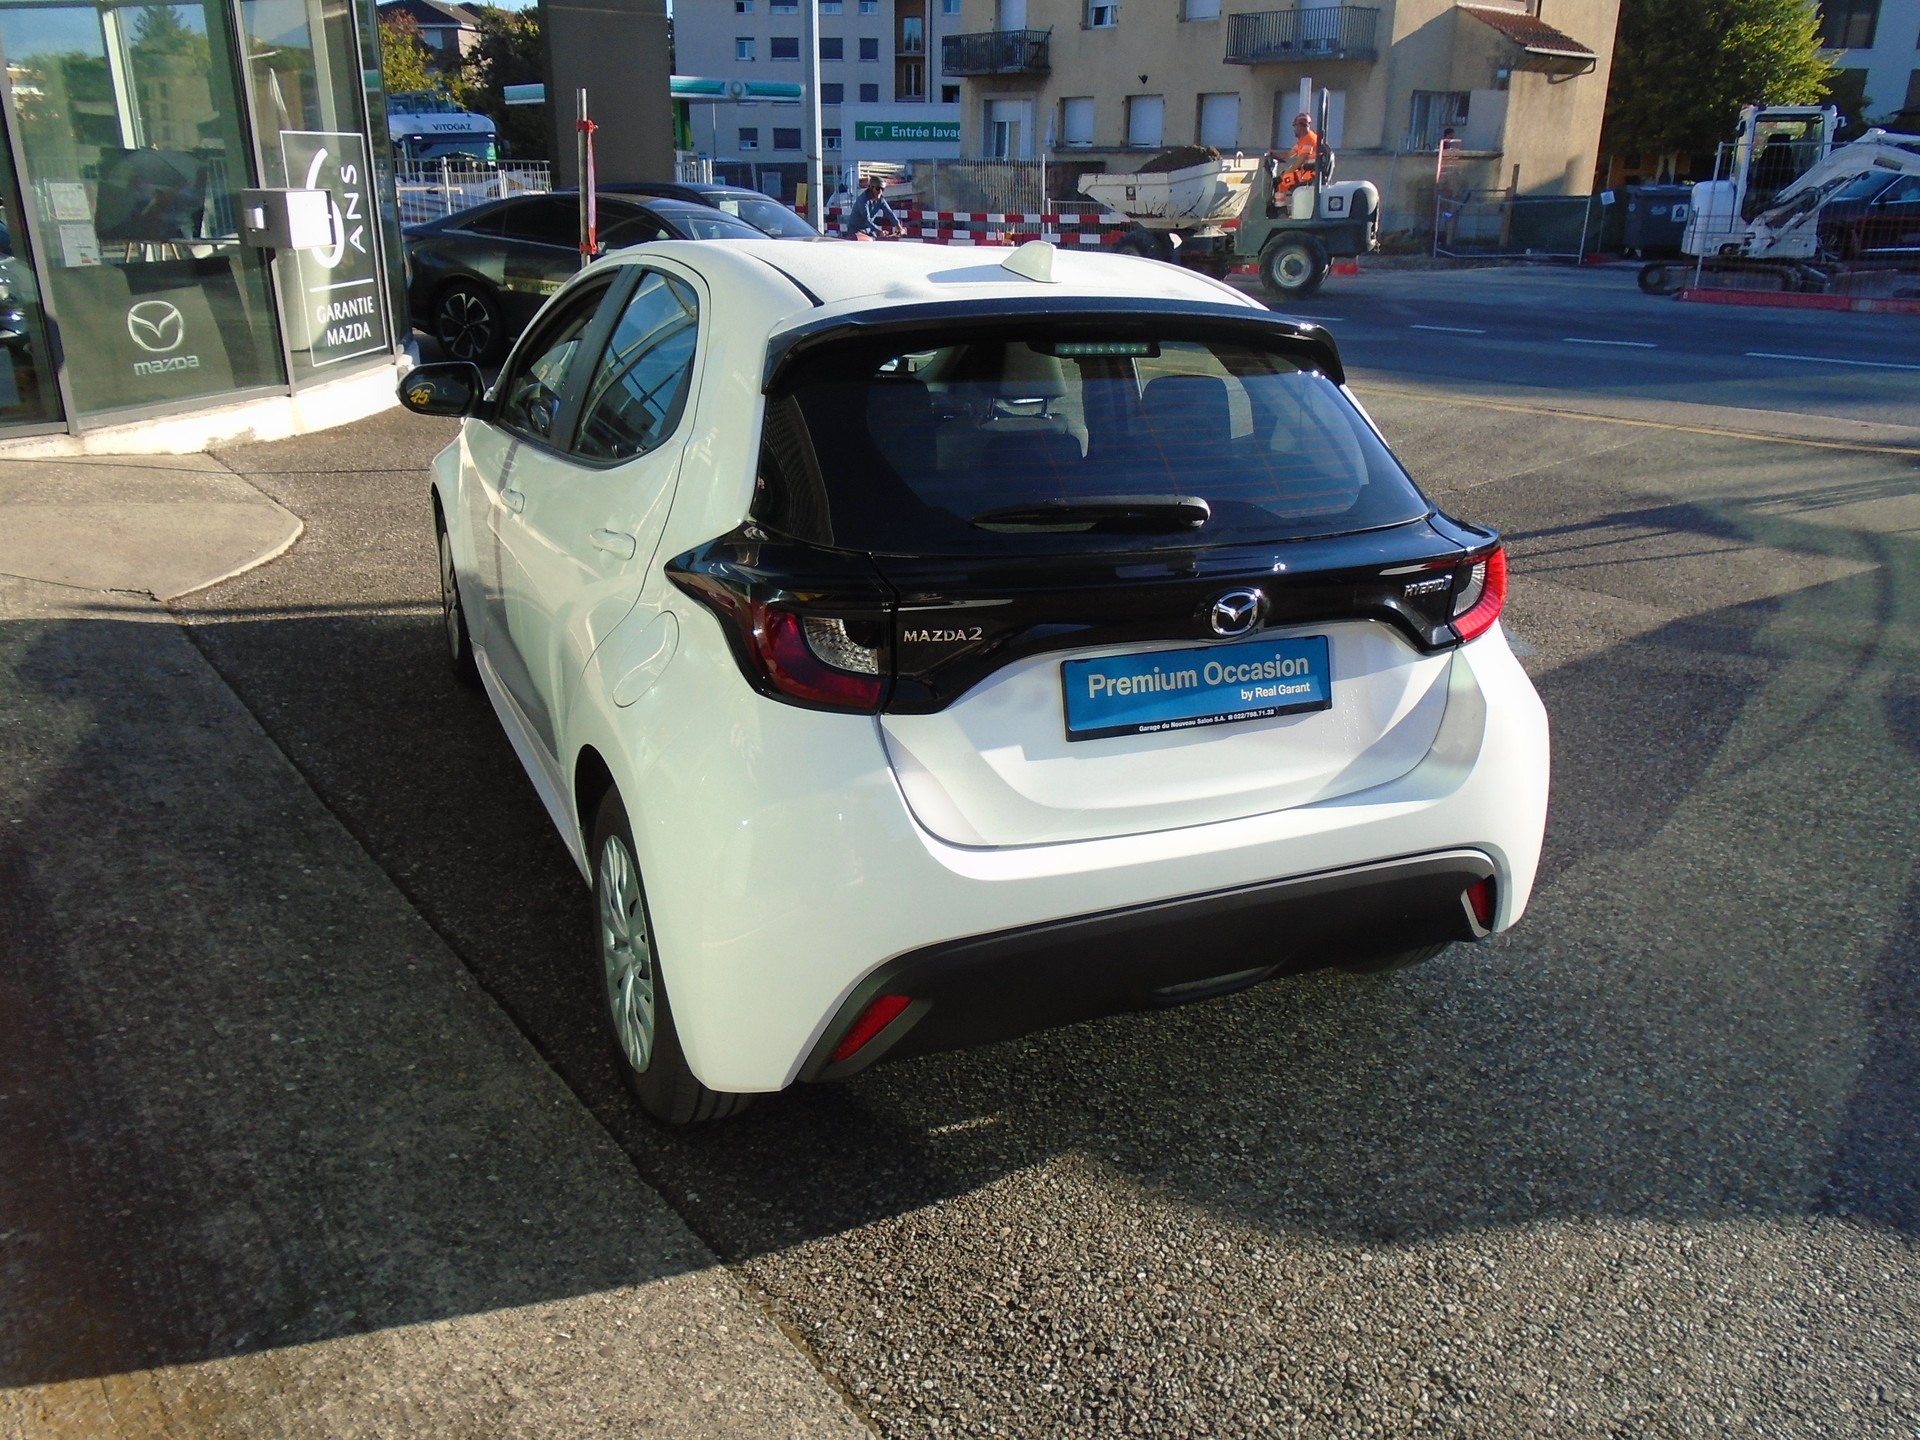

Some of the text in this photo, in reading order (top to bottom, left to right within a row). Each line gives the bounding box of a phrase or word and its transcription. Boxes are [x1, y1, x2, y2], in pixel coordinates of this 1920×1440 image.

[432, 123, 472, 131] VITOGAZ
[891, 126, 930, 137] Entrée
[341, 164, 366, 254] ANS
[316, 295, 375, 324] GARANTIE
[326, 321, 372, 347] MAZDA
[1403, 578, 1446, 598] HYBRID
[1088, 653, 1309, 699] Premium Occasion
[1240, 682, 1311, 702] by Real Garant
[1170, 720, 1196, 728] Nouveau
